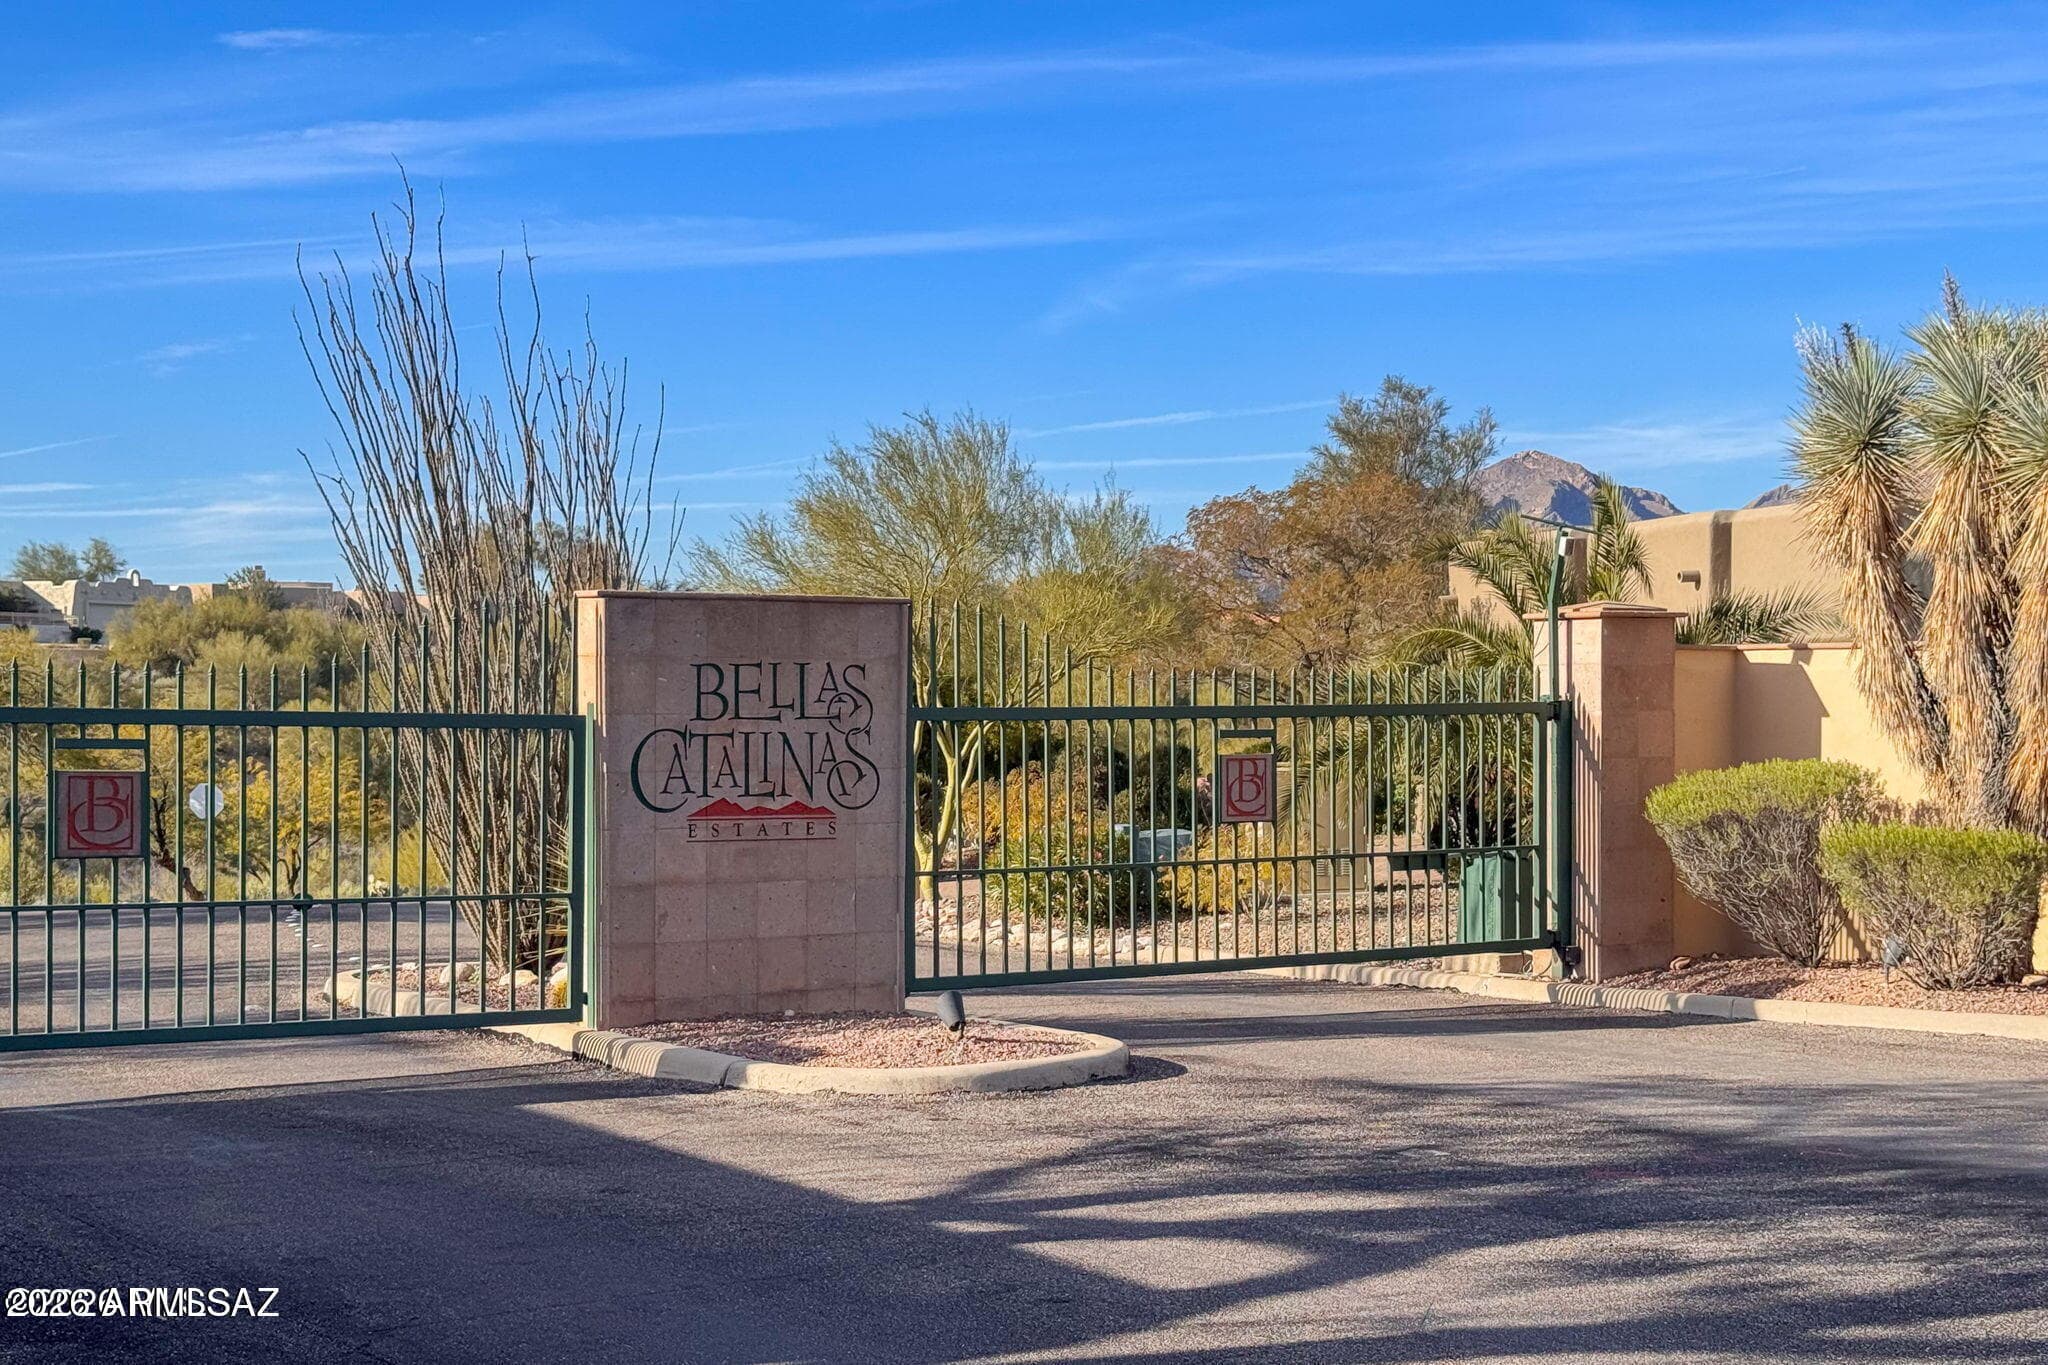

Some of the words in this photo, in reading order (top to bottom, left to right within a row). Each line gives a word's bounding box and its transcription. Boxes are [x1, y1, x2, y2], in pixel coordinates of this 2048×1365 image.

[690, 660, 873, 734] BELLAS
[631, 725, 880, 813] CATALINAS
[688, 821, 837, 838] ESTATES
